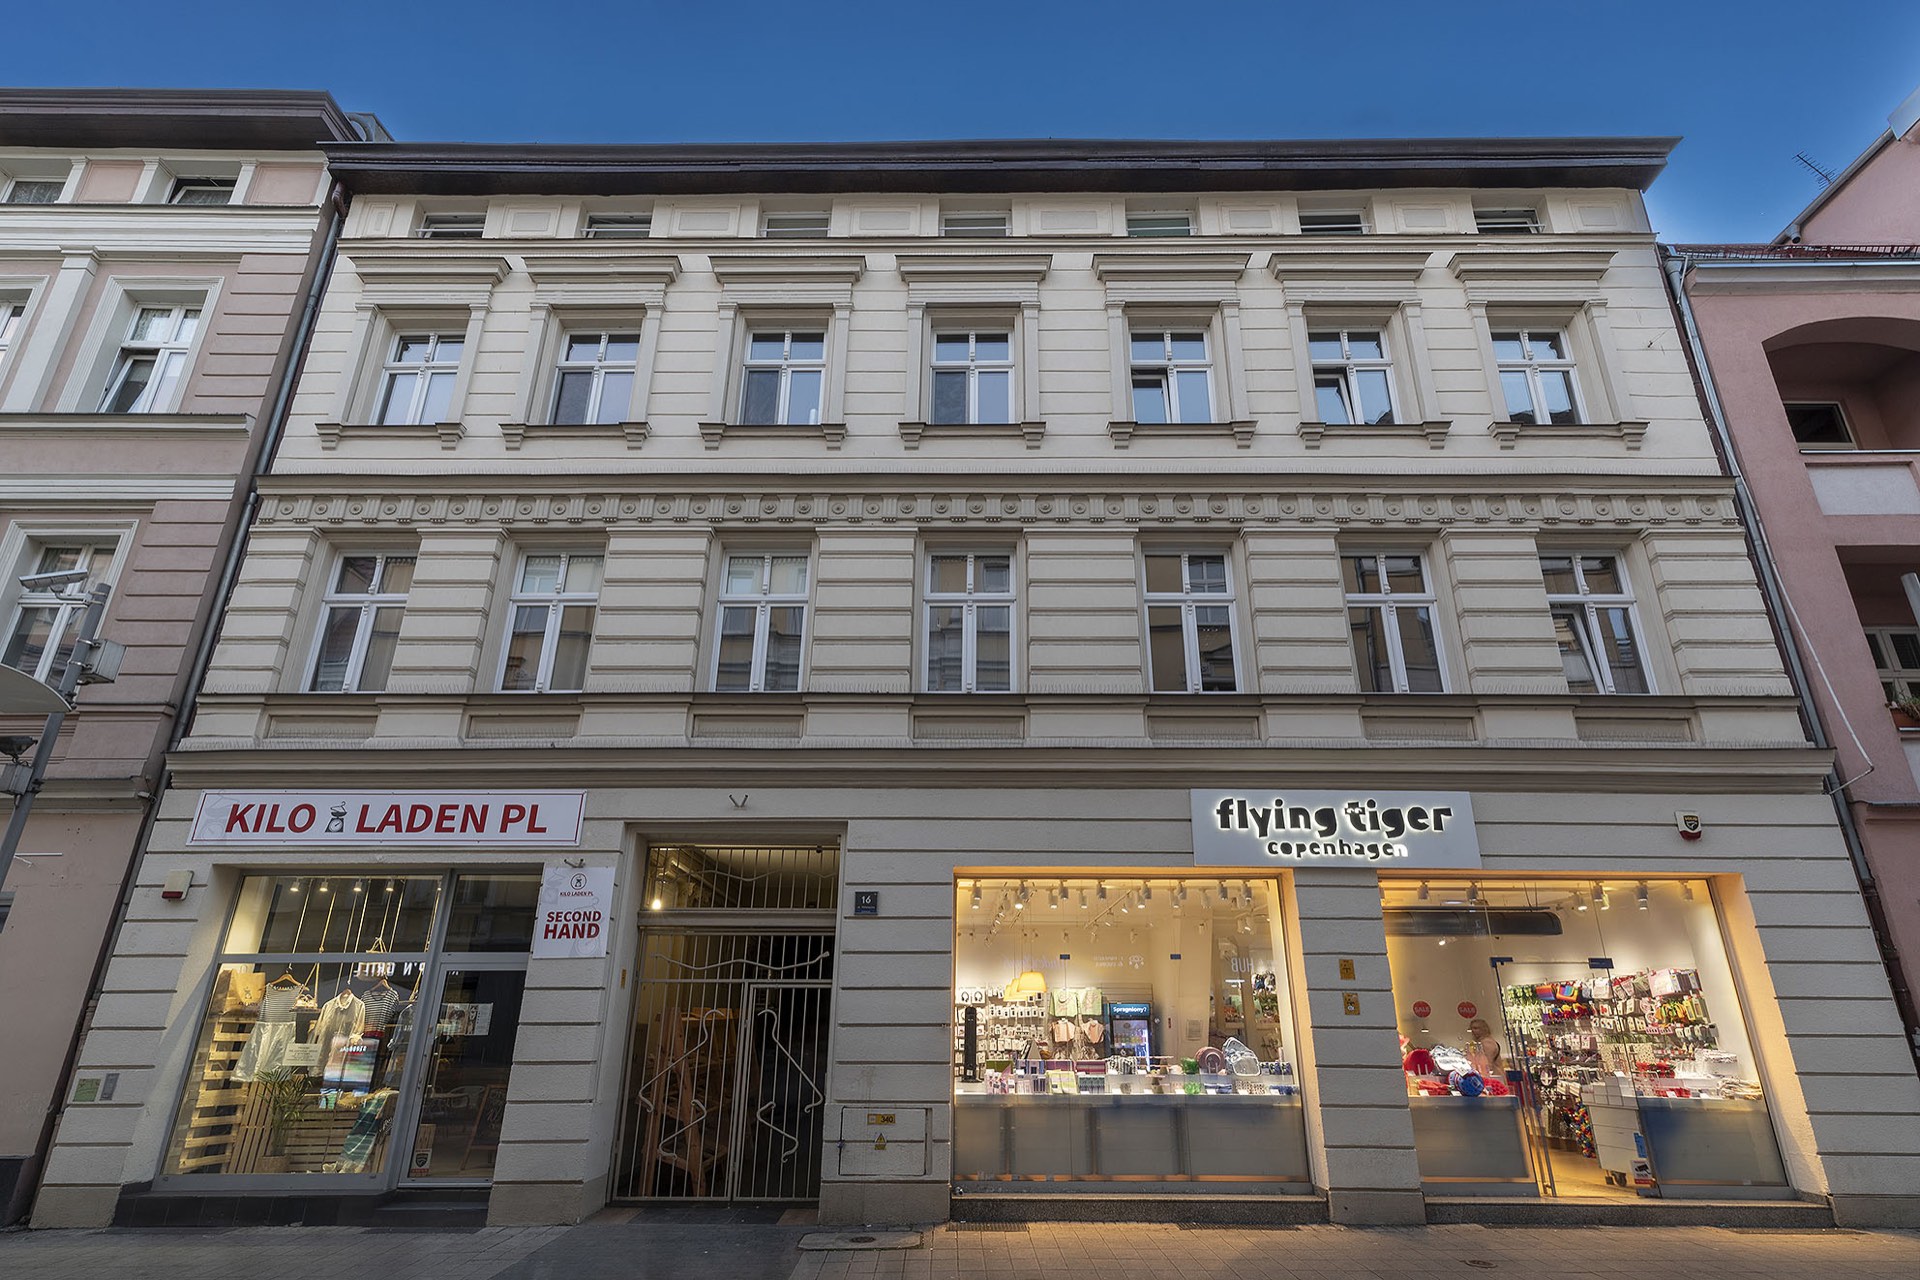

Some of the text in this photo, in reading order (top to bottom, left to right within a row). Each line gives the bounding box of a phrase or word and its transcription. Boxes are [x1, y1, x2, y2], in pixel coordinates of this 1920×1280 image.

[225, 803, 548, 834] KILO LADEN PL
[1216, 798, 1453, 839] flying tiger
[1267, 839, 1409, 860] copenhagen
[861, 895, 871, 904] 16
[546, 911, 602, 923] SECOND
[543, 923, 600, 939] HAND
[880, 1115, 894, 1123] 340
